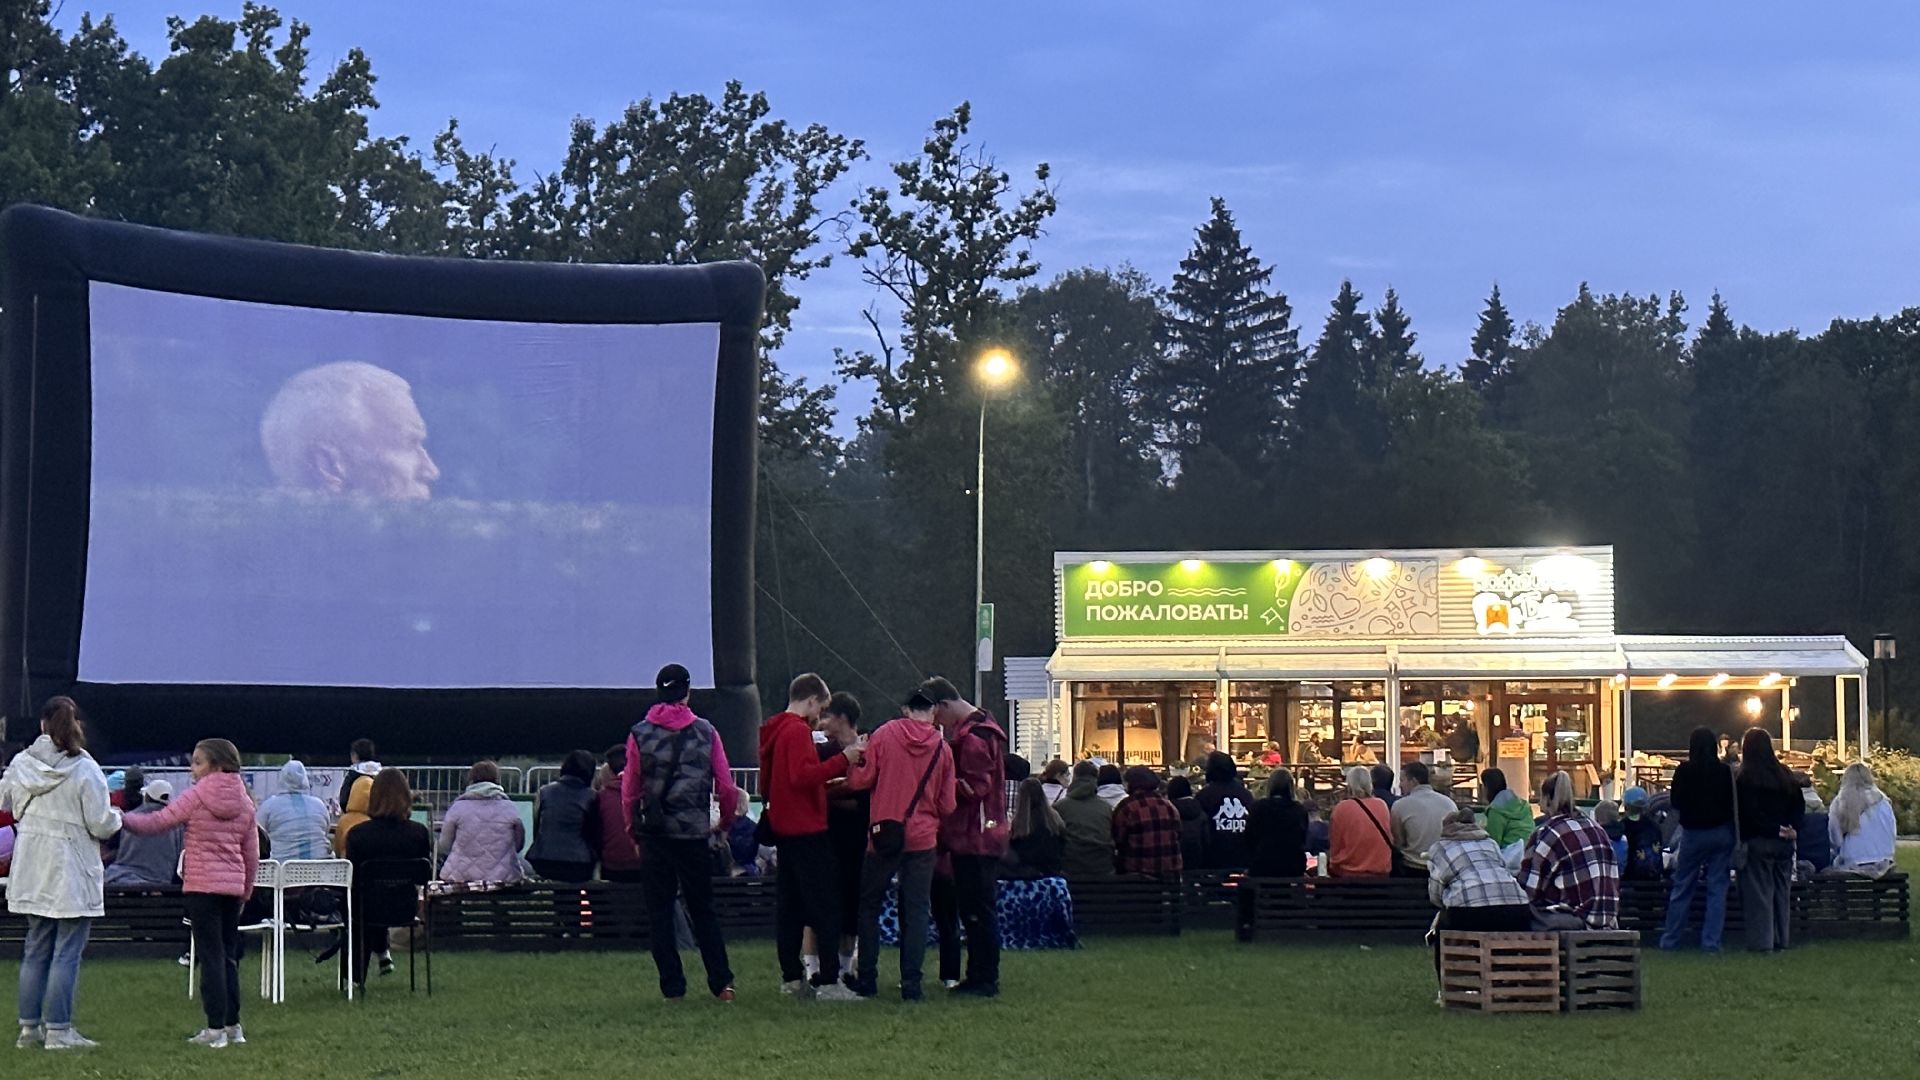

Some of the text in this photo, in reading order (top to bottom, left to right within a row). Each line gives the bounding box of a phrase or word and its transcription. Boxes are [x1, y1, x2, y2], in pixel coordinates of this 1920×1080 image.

[1085, 580, 1163, 600] ДОБРО
[1086, 604, 1249, 621] ПОЖАЛОВАТЬ!
[1215, 818, 1247, 833] Kapp
